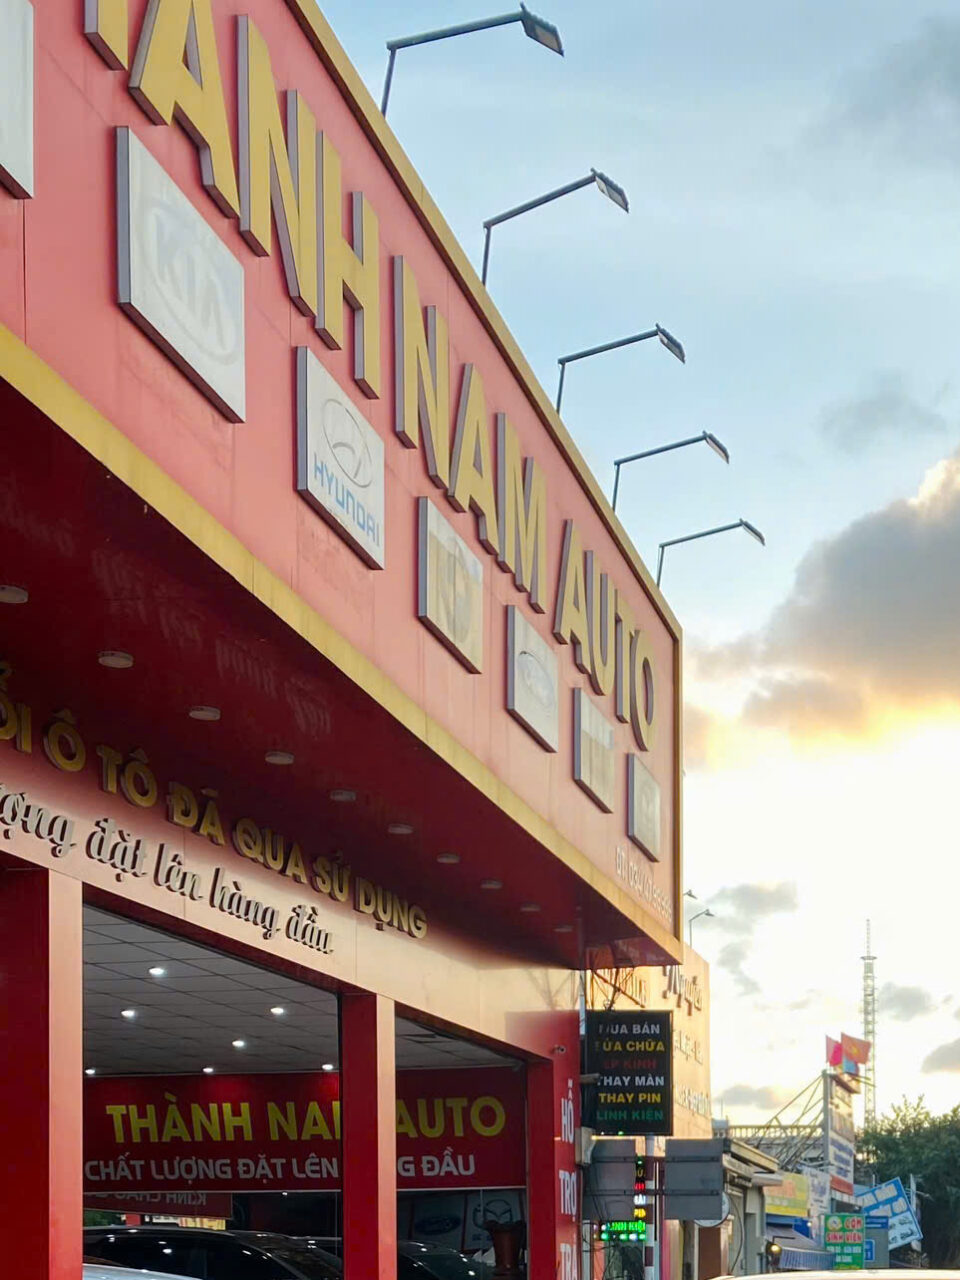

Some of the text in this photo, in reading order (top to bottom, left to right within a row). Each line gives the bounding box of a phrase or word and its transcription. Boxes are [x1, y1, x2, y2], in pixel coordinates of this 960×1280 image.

[84, 0, 656, 753] ANH NAM AUTO
[313, 452, 380, 547] HYUNDAI
[43, 707, 87, 772] Ô
[96, 744, 158, 808] TÔ
[166, 781, 226, 846] ĐÃ
[232, 817, 308, 884] QUA
[312, 850, 351, 902] SỬ
[353, 876, 428, 939] DỤNG
[0, 783, 76, 858] ợng
[153, 842, 203, 901] lên
[209, 867, 281, 940] hàng
[285, 904, 334, 955] đầu
[632, 1021, 660, 1035] BÁN
[598, 1093, 661, 1103] THAY PIN
[634, 1073, 665, 1087] MÀN
[106, 1092, 251, 1143] THÀNH
[267, 1100, 341, 1141] NA
[84, 1151, 145, 1182] CHẤT
[150, 1157, 231, 1185] LƯỢNG
[237, 1154, 286, 1184] ĐẶT
[292, 1153, 340, 1179] LÊN
[420, 1146, 476, 1177] ĐẦU
